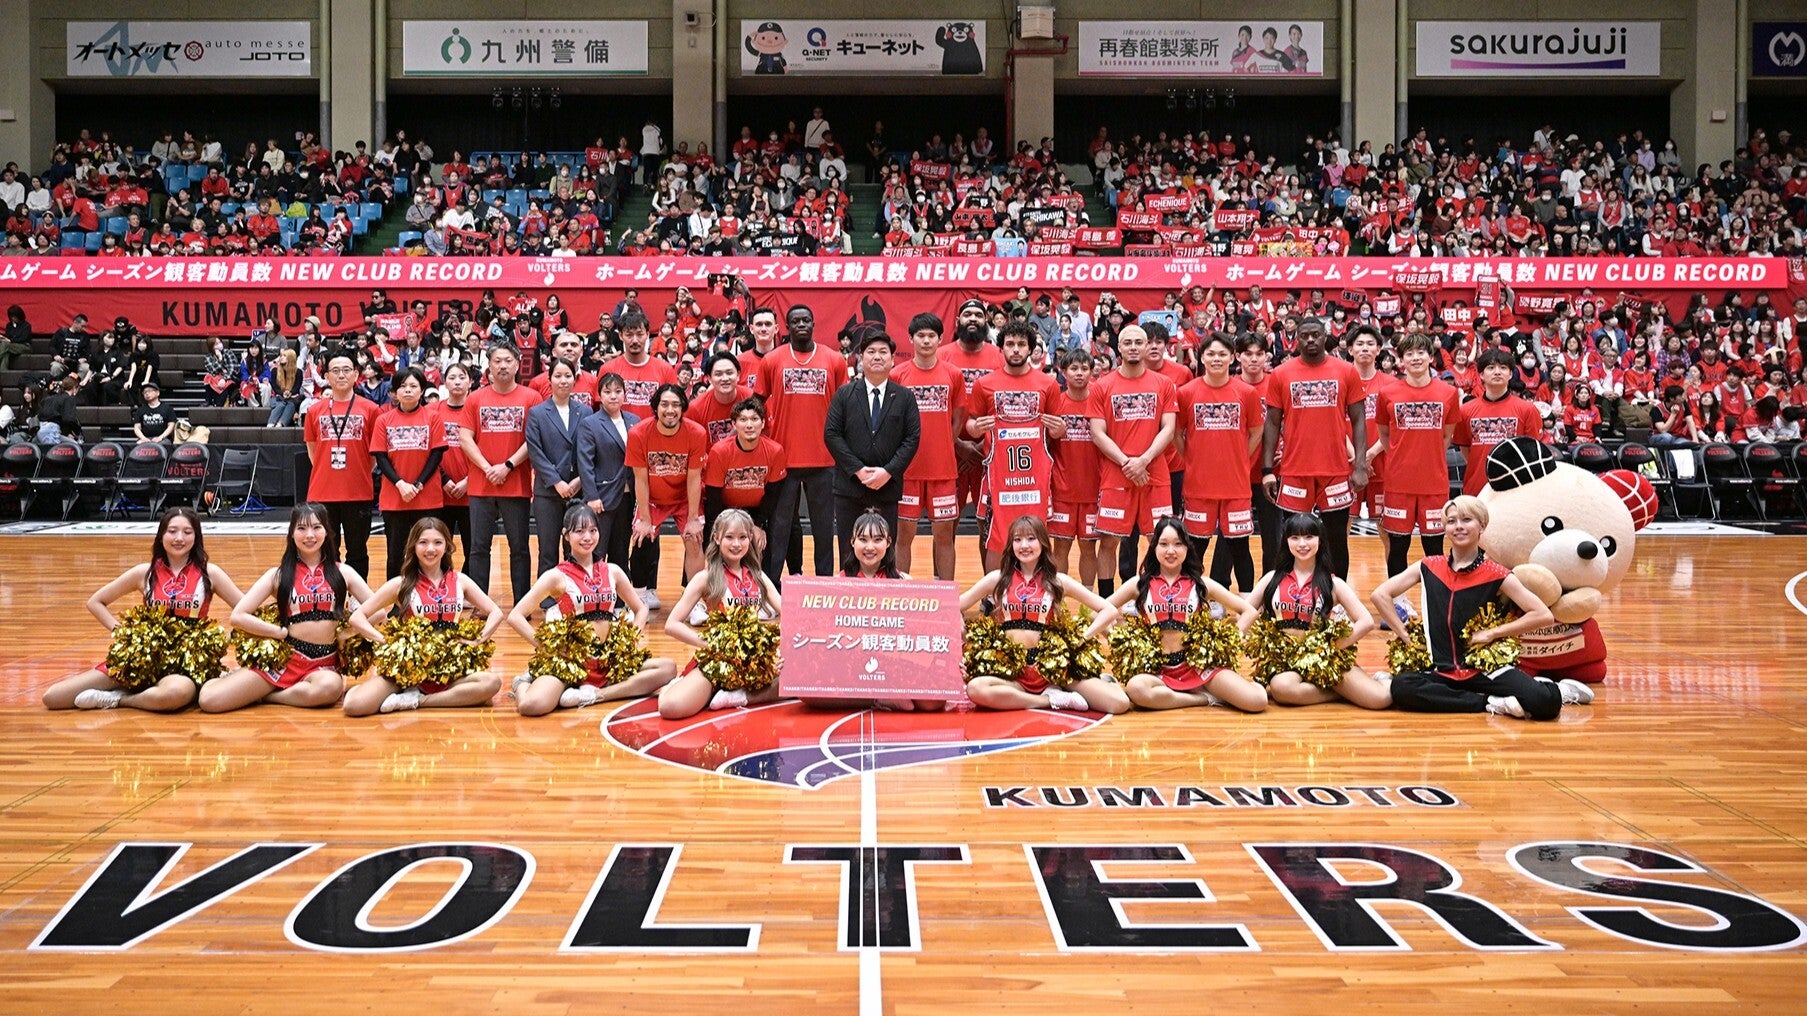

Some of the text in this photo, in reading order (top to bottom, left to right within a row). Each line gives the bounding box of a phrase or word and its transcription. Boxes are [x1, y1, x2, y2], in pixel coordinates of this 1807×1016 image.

[205, 40, 241, 48] auto
[837, 39, 924, 55] キューネット
[1099, 38, 1219, 58] 再春館製薬所
[1450, 27, 1627, 55] sakurajuji
[73, 42, 181, 61] オートメッセ
[239, 52, 304, 61] JOTO
[482, 39, 609, 64] 九州警備
[1120, 213, 1158, 224] 石川海斗
[86, 262, 273, 283] シーズン観客動員数
[280, 263, 335, 281] NEW
[341, 263, 402, 281] CLUB
[409, 263, 503, 281] RECORD
[528, 263, 571, 272] VOLTERS
[595, 262, 710, 281] ホームゲーム
[915, 263, 970, 281] NEW
[977, 263, 1038, 281] CLUB
[1045, 263, 1139, 281] RECORD
[1164, 264, 1207, 273] VOLTERS
[1226, 262, 1341, 281] ホームゲーム
[1545, 263, 1598, 281] NEW
[1606, 263, 1666, 281] CLUB
[1674, 263, 1766, 281] RECORD
[163, 301, 343, 328] KUMAMOTO
[1007, 444, 1032, 472] 16
[1005, 476, 1036, 486] NISHIDA
[1001, 493, 1038, 503] 肥後銀行
[416, 603, 462, 613] VOLTERS
[802, 594, 940, 612] NEW CLUB RECORD
[1002, 603, 1047, 613] VOLTERS
[1147, 603, 1194, 614] VOLTERS
[835, 615, 905, 629] HOME GAME
[792, 632, 950, 653] シーズン観客動員数
[982, 786, 1461, 808] KUMAMOTO
[27, 841, 1805, 954] VOLTERS
